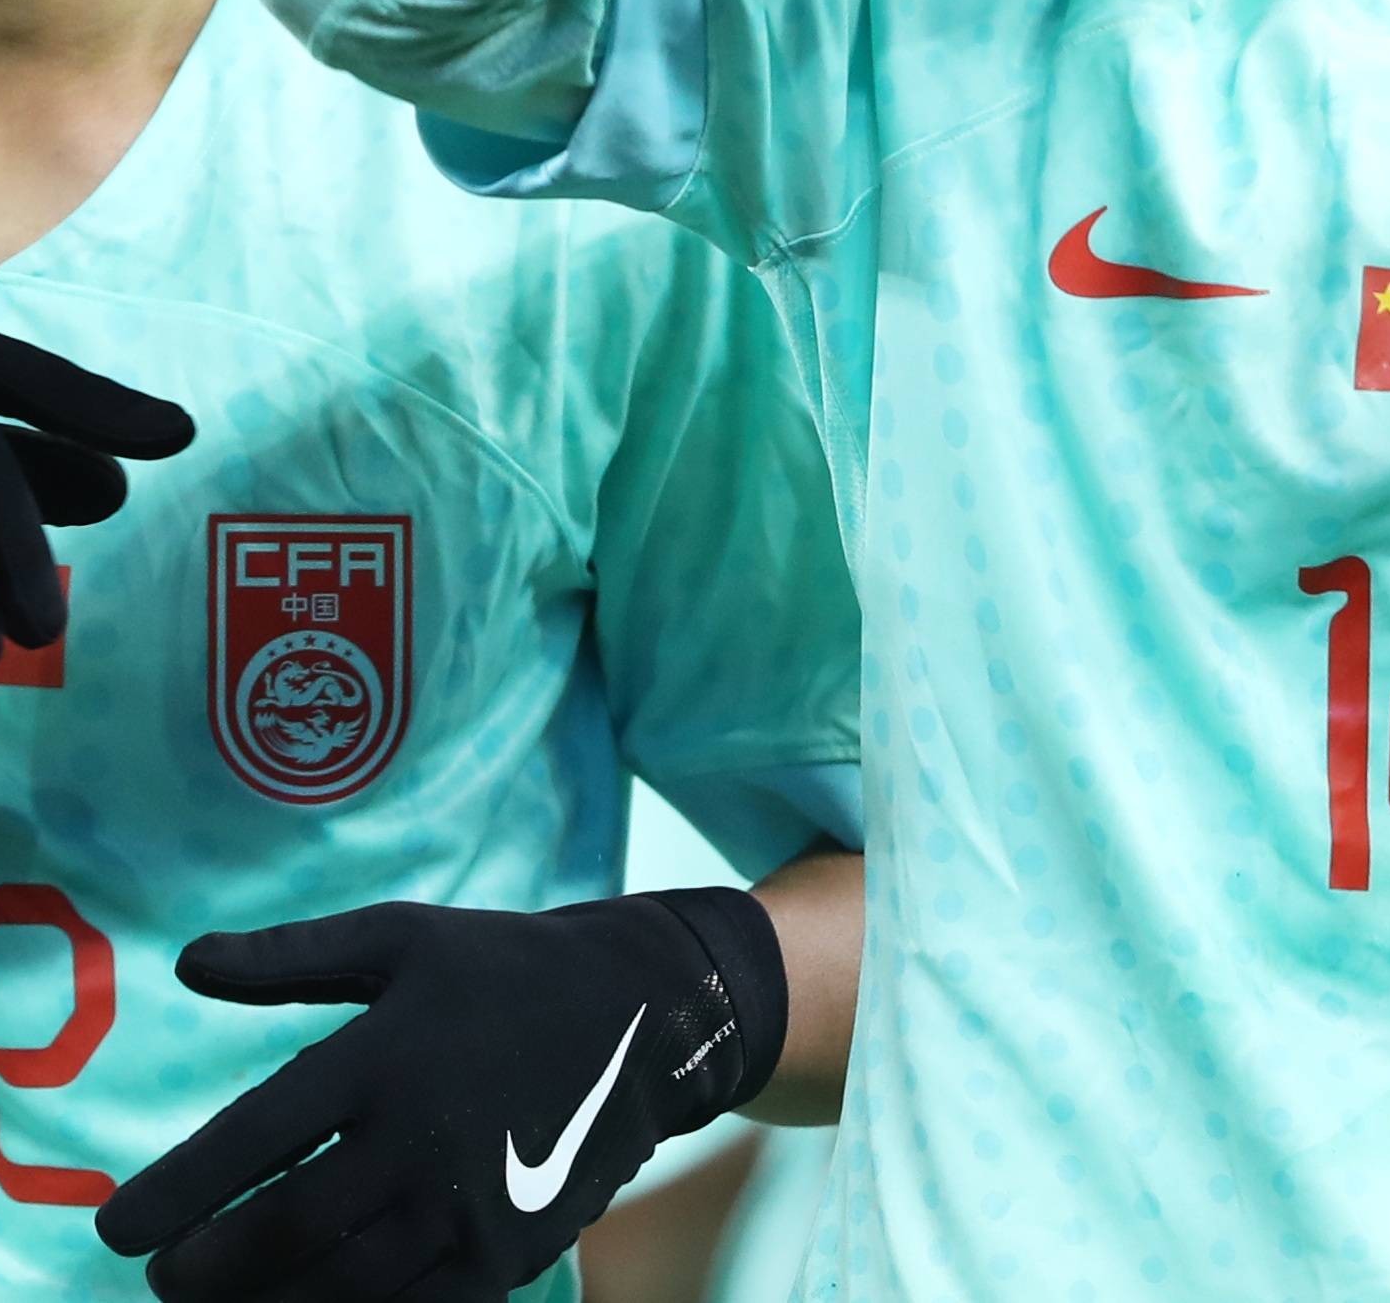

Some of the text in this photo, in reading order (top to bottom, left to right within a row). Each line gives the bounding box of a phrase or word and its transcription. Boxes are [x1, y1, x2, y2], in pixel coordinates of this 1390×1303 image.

[235, 541, 386, 587] CFA
[281, 593, 340, 622] 中国
[671, 1018, 736, 1079] THERMA-FIT
